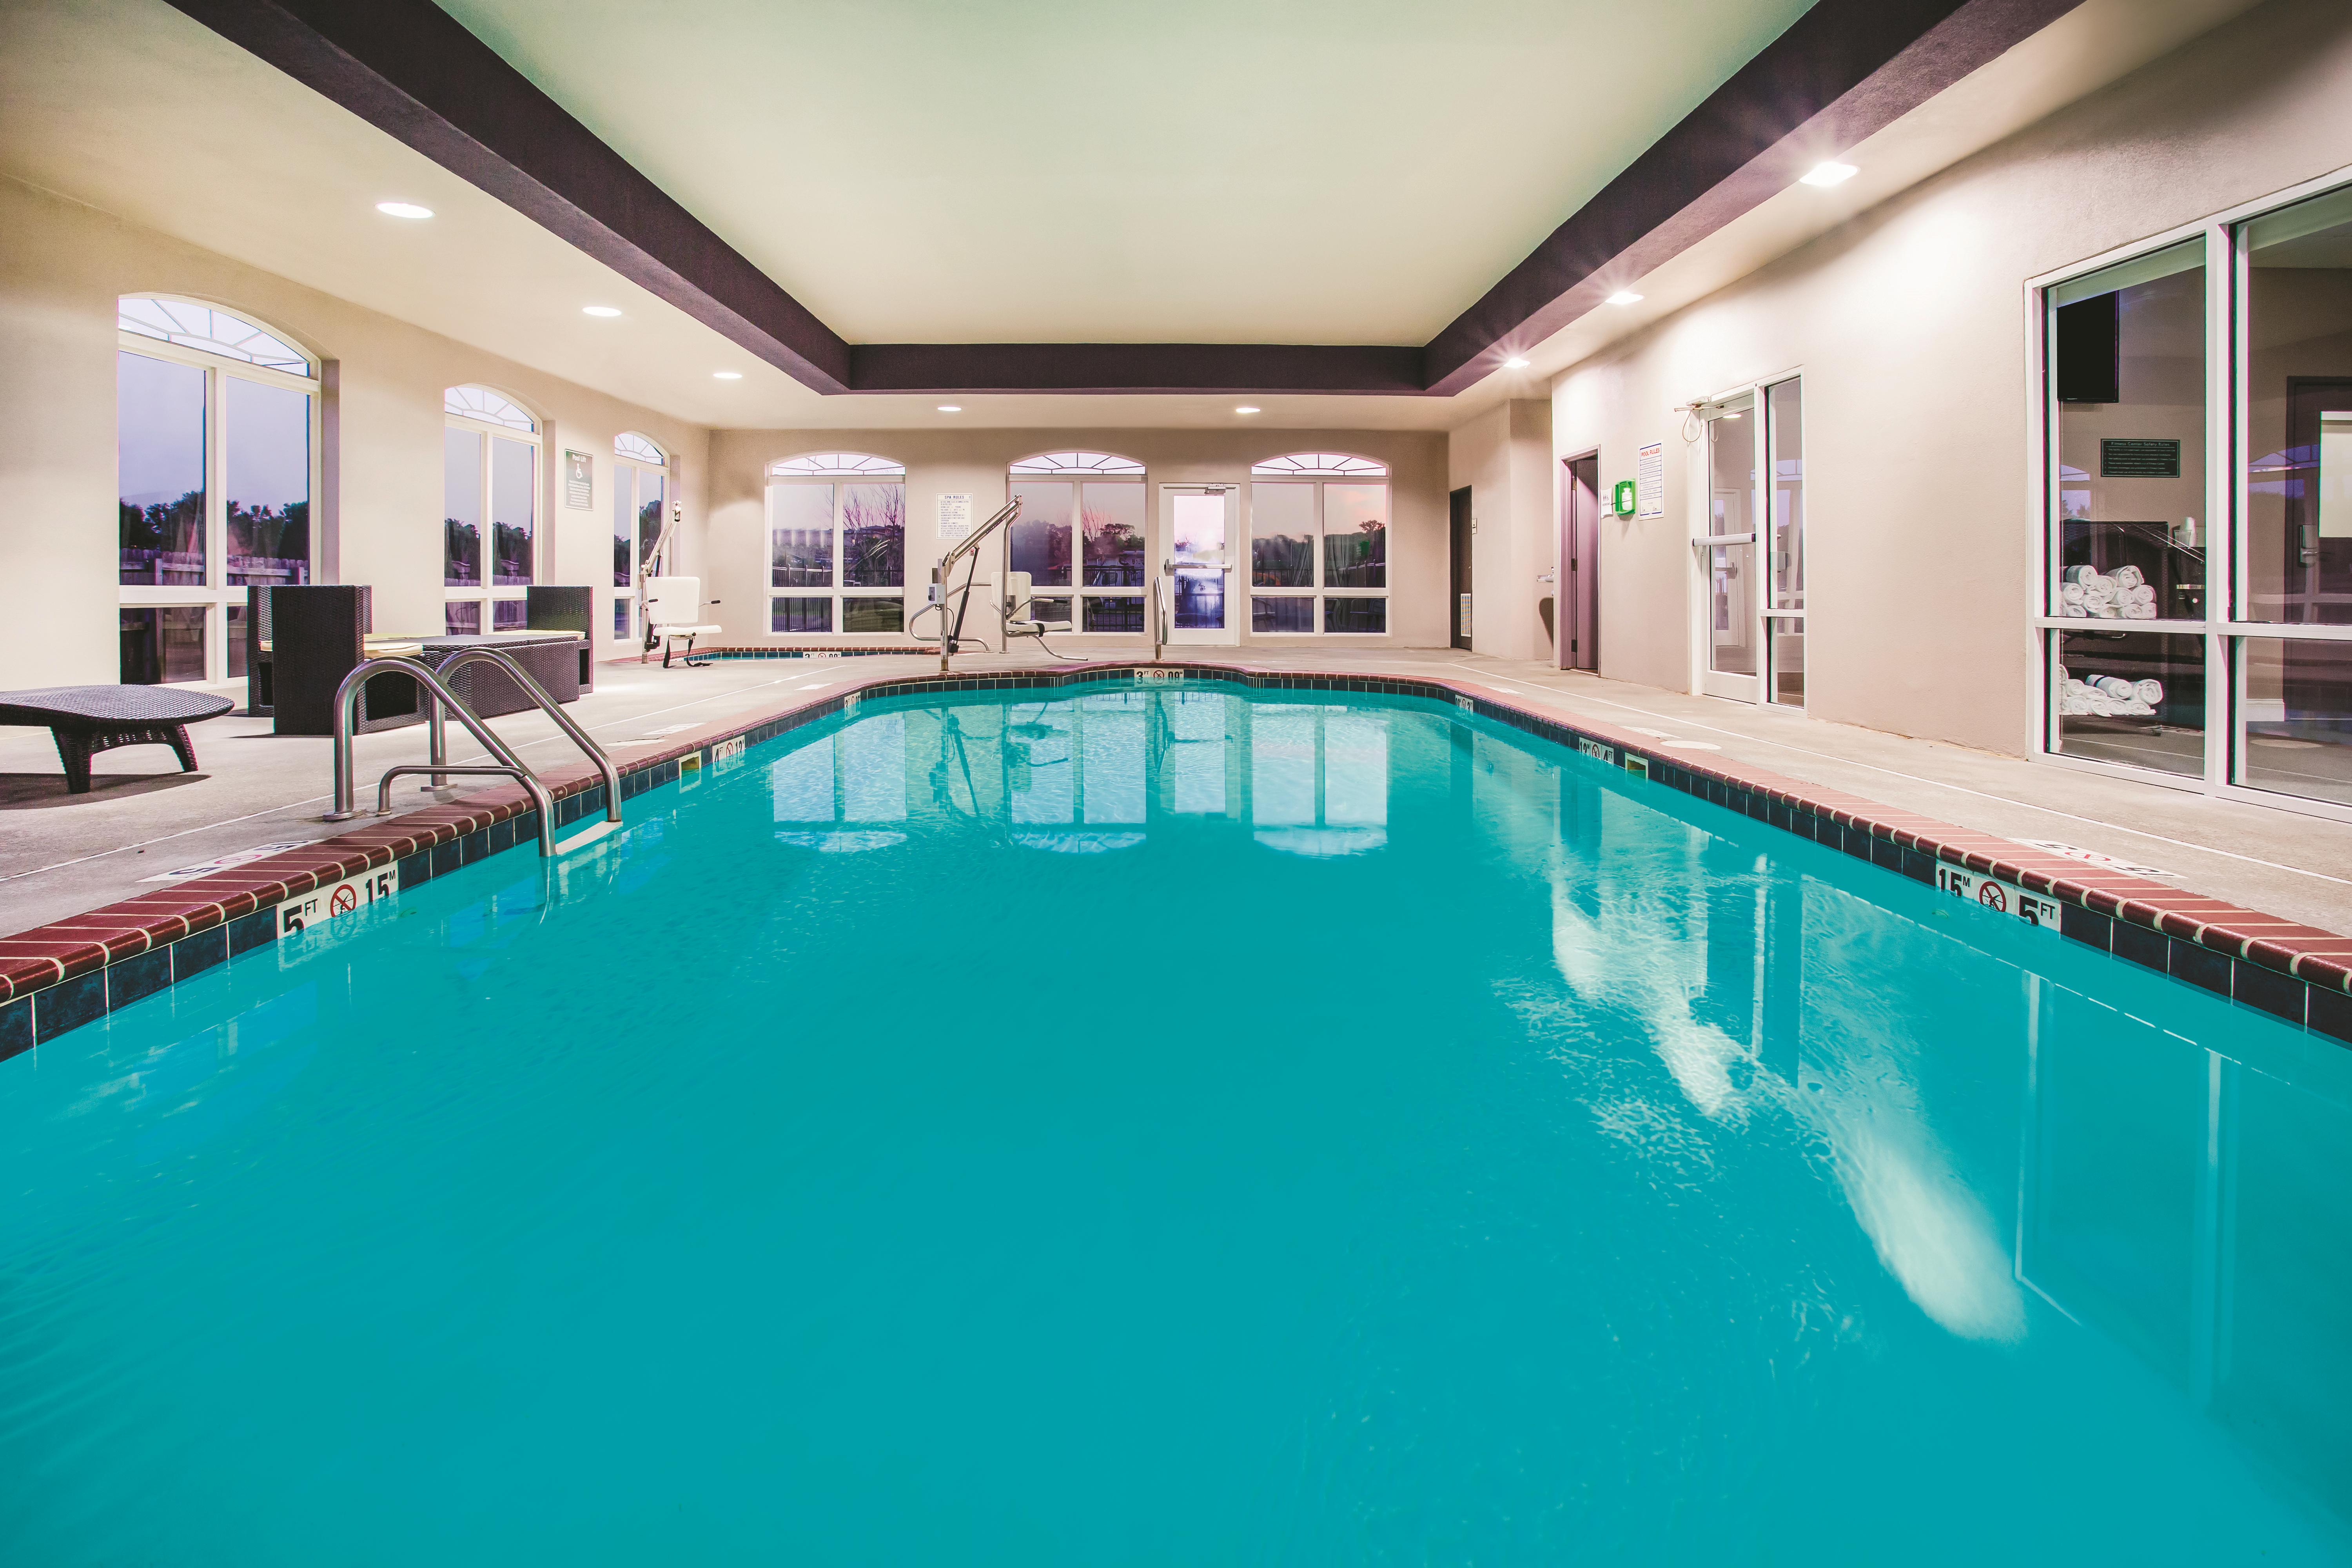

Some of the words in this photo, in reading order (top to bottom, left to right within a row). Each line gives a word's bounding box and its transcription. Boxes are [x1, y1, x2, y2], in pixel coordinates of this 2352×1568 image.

[283, 904, 305, 937] 5
[305, 898, 318, 916] FT
[1963, 876, 1970, 887] M
[2019, 895, 2039, 927] 5
[2040, 902, 2055, 920] FT
